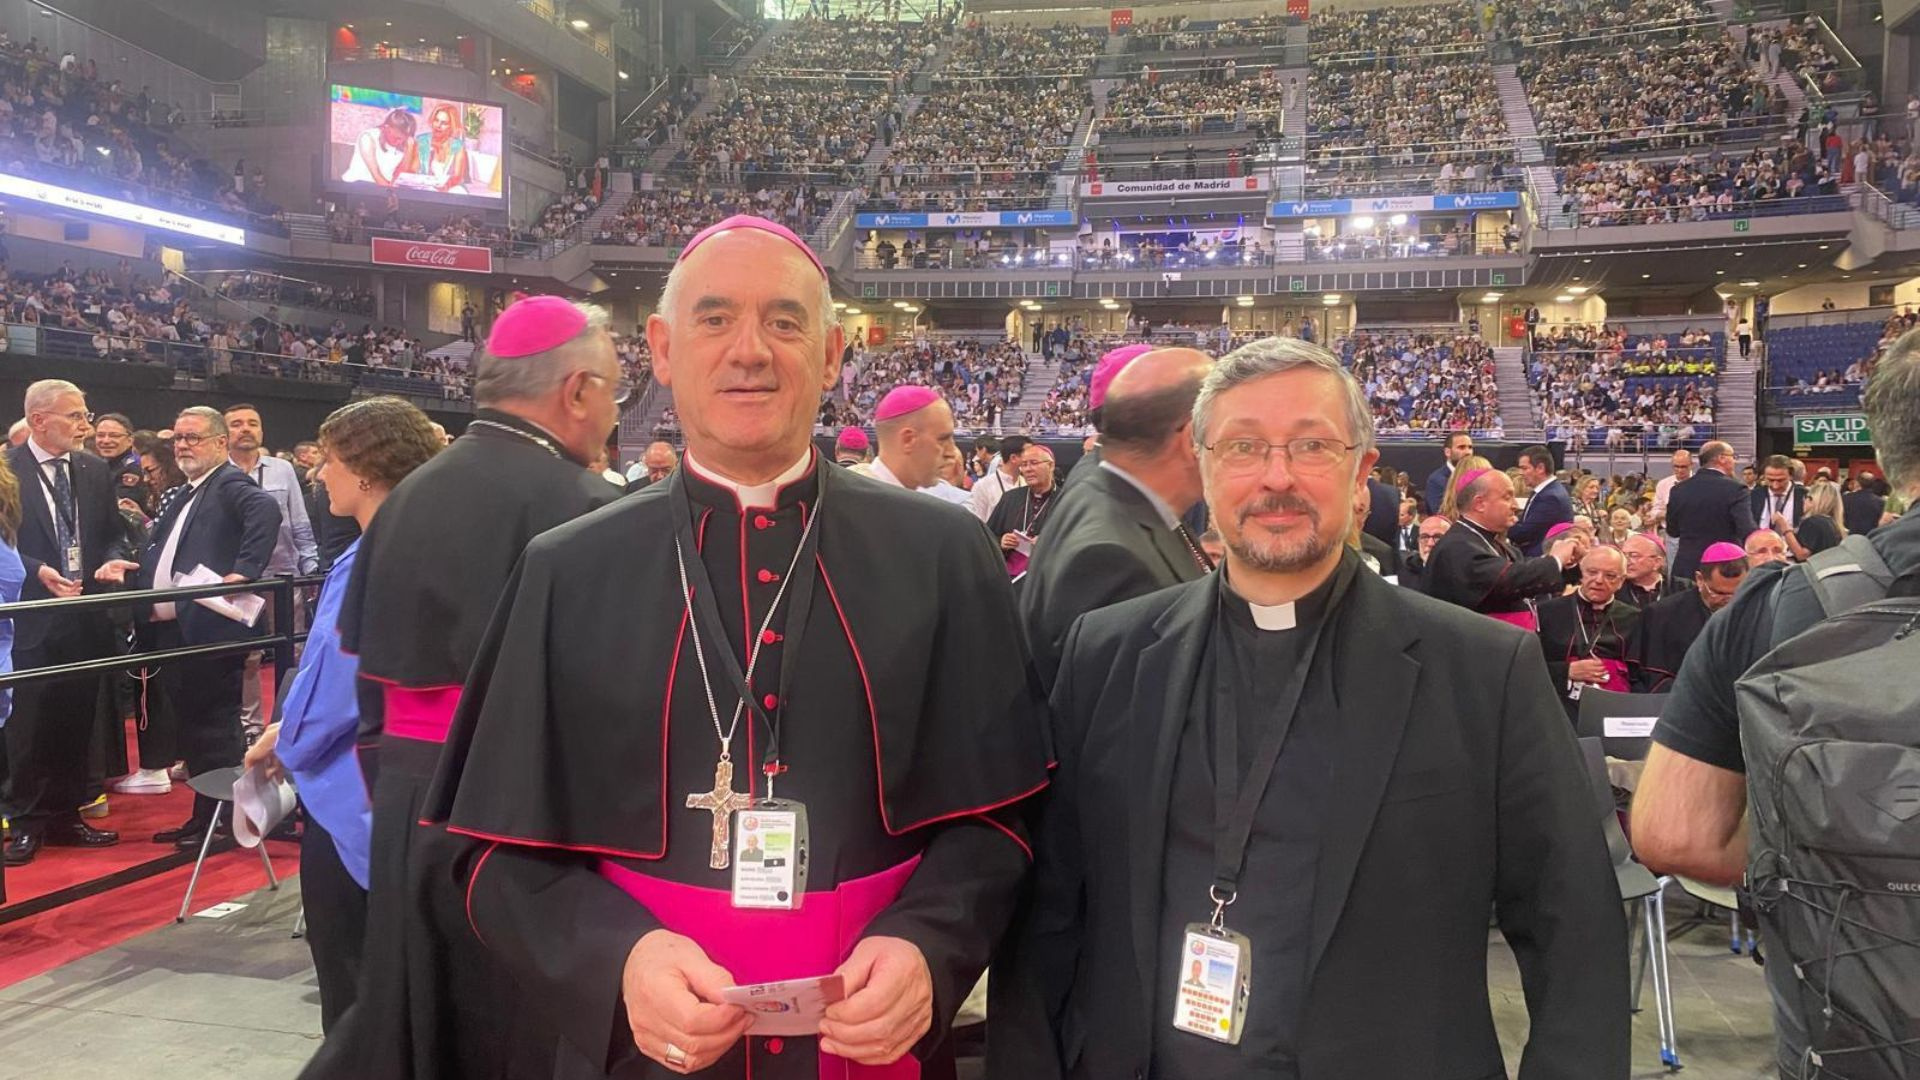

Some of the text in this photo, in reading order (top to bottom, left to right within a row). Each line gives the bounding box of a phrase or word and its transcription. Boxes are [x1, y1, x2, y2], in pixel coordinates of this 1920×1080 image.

[1117, 180, 1231, 193] Comunidad de Madrid
[1801, 418, 1872, 432] SALID
[1824, 431, 1860, 442] EXIT
